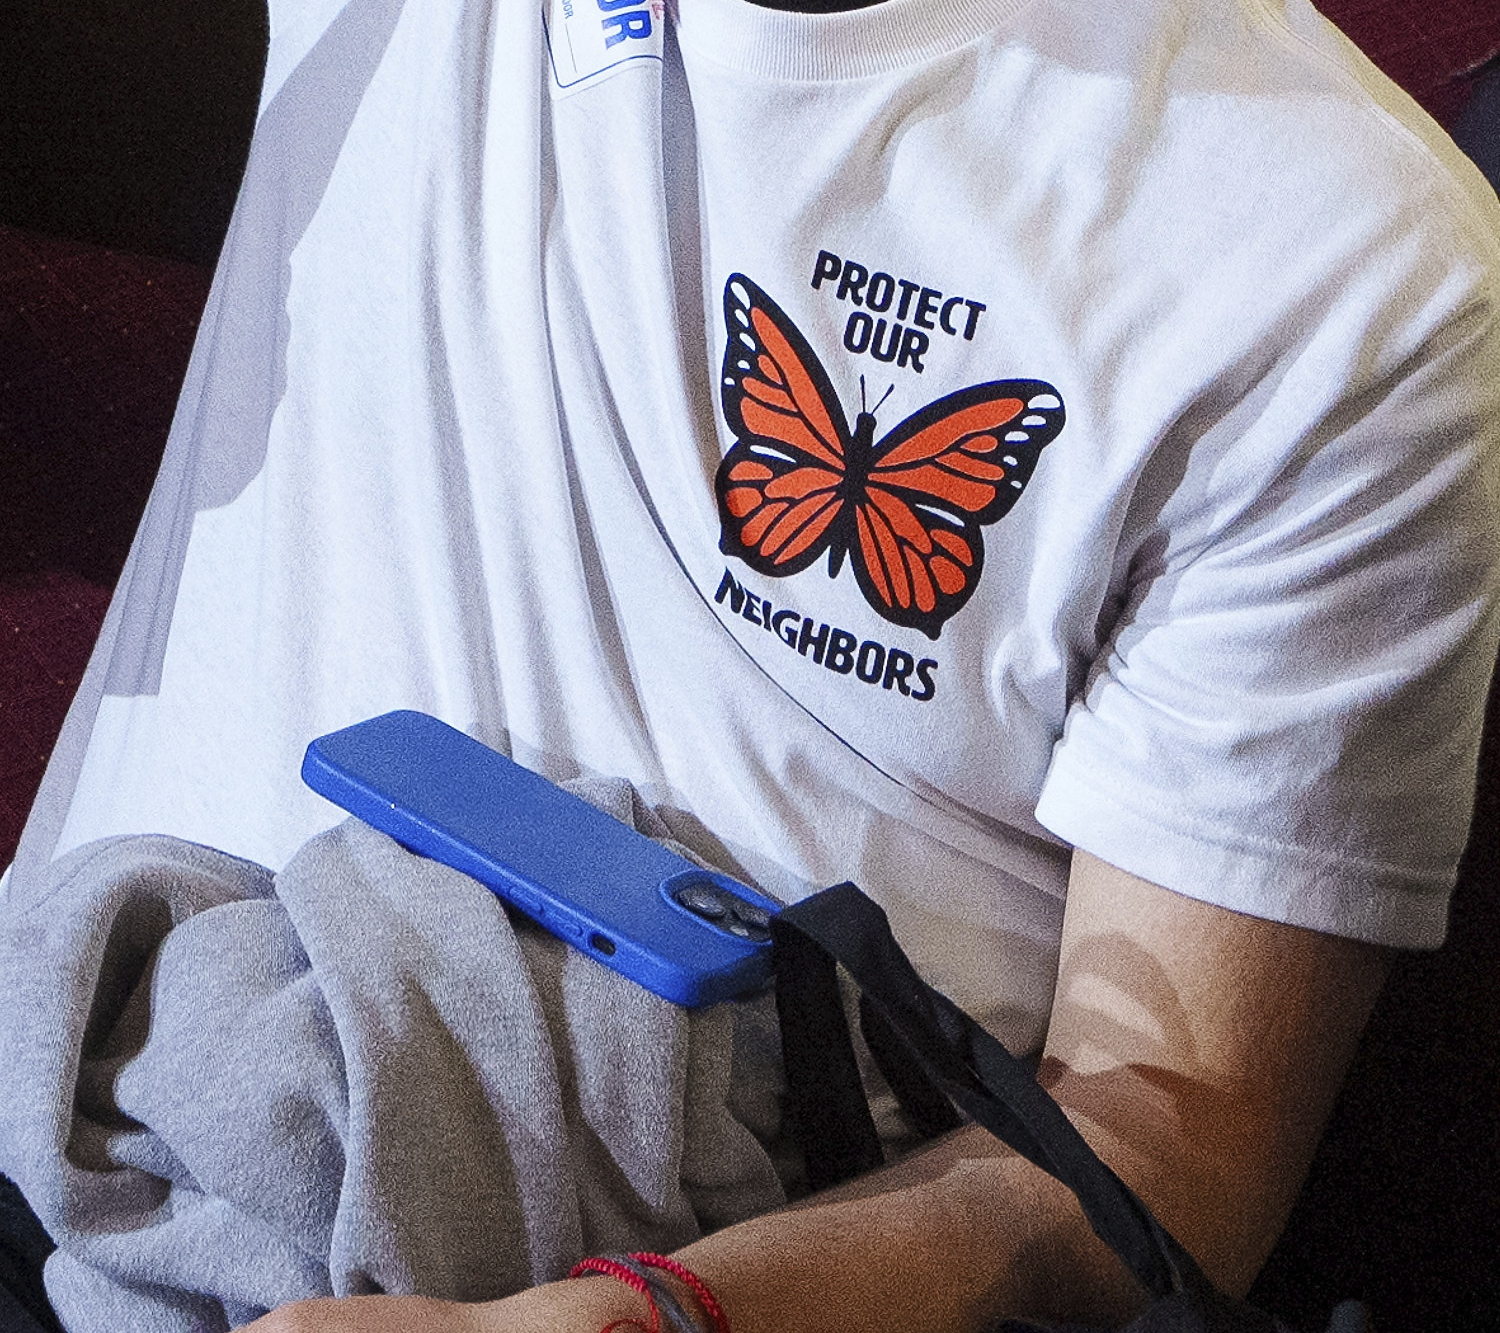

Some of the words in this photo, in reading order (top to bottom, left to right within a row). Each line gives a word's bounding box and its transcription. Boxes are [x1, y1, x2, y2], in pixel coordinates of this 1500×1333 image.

[811, 249, 987, 341] PROTECT
[843, 311, 930, 373] OUR
[714, 566, 939, 702] NEIGHBORS
